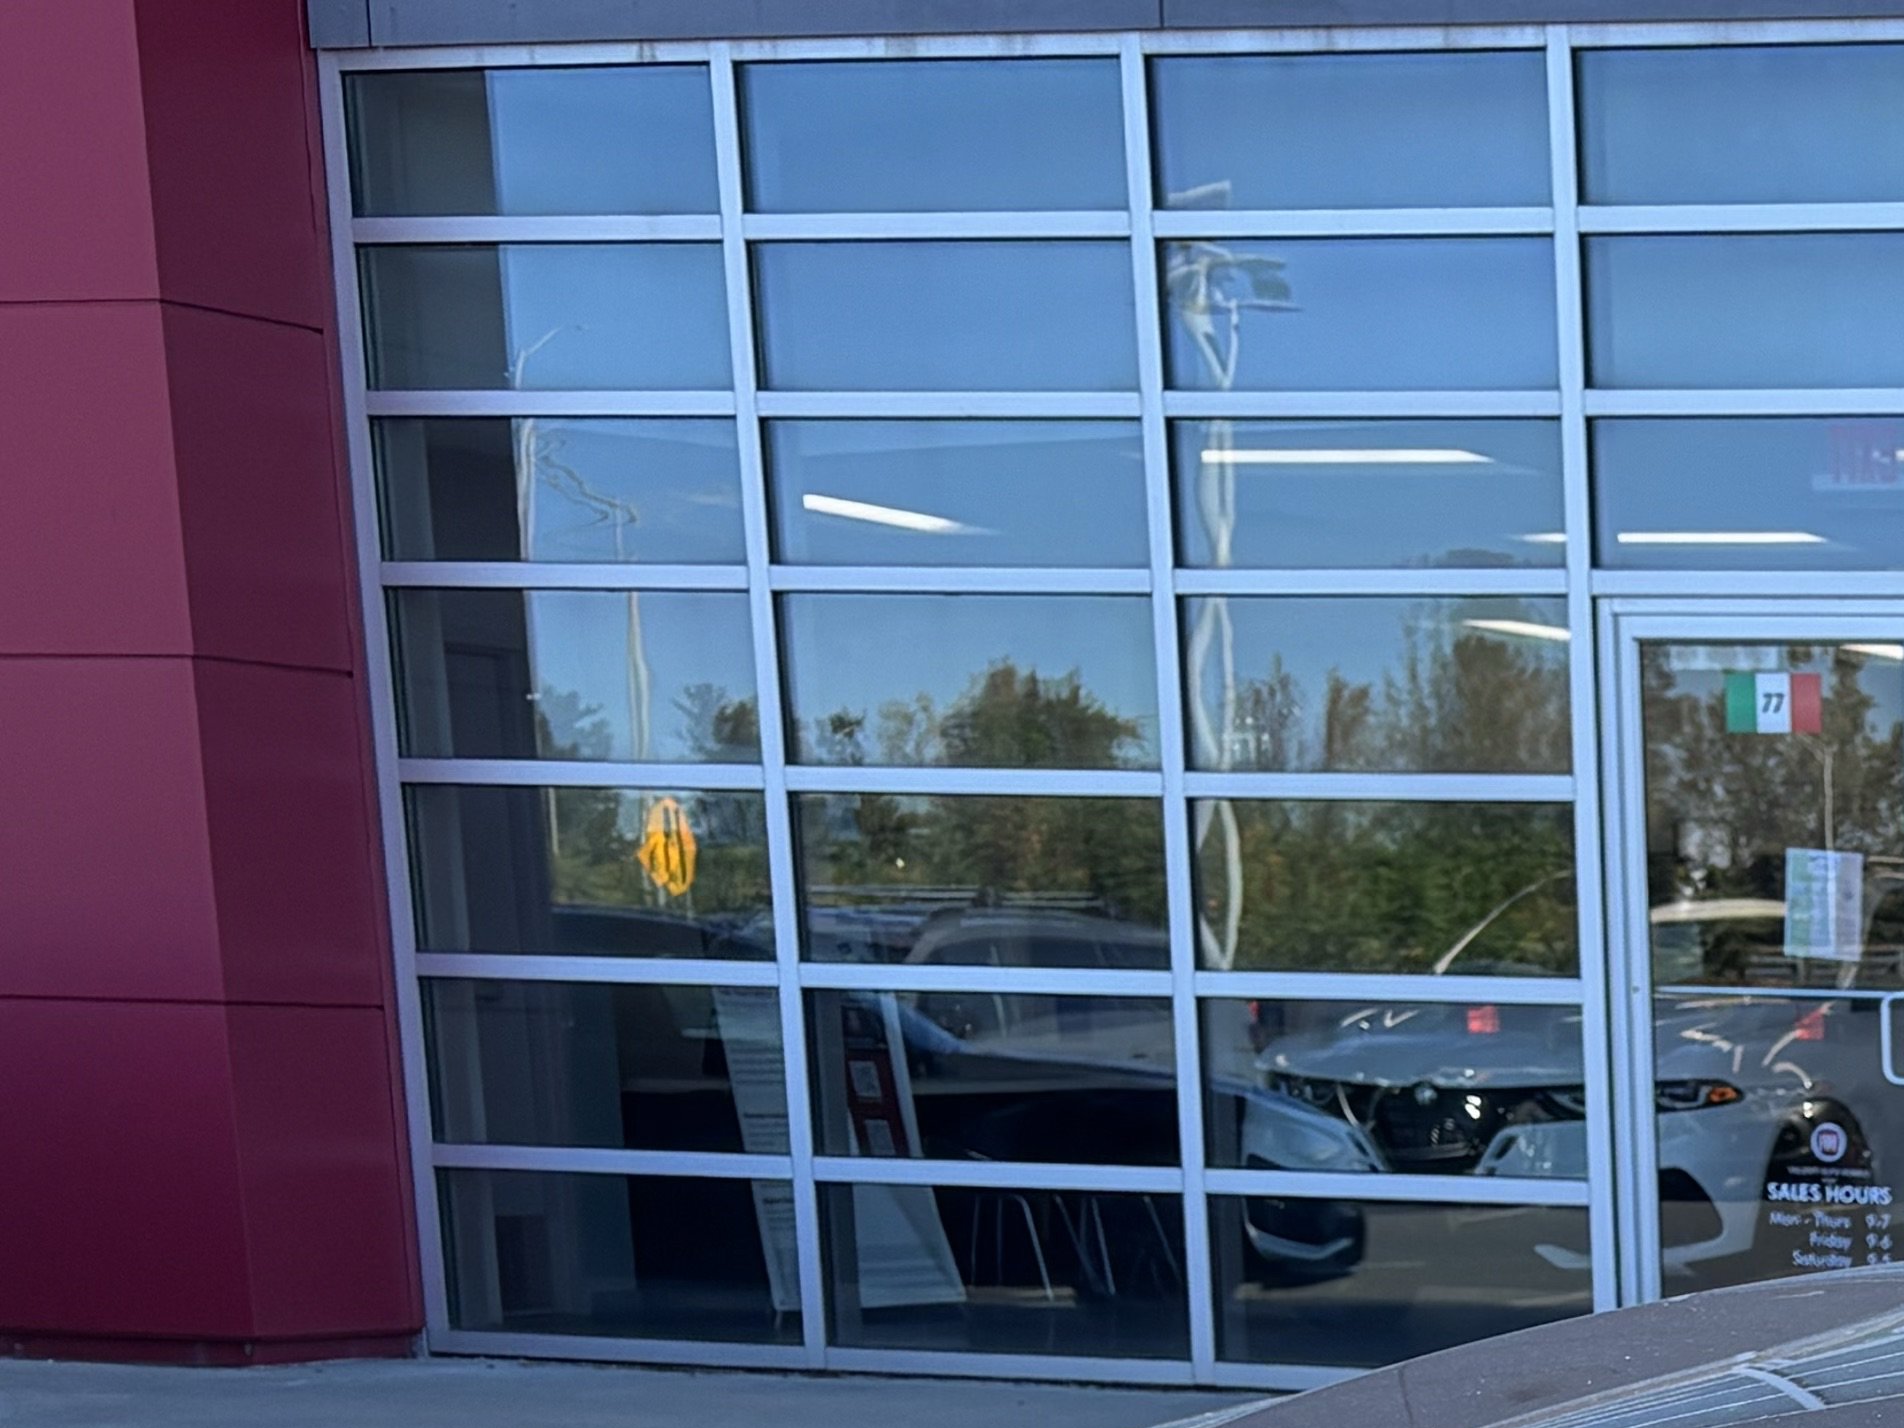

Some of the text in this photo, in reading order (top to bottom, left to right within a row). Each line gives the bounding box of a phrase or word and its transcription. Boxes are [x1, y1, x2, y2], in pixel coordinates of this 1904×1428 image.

[1767, 1182, 1893, 1205] SALES HOURS
[1809, 1231, 1853, 1251] Friday
[1792, 1249, 1853, 1268] Saturday
